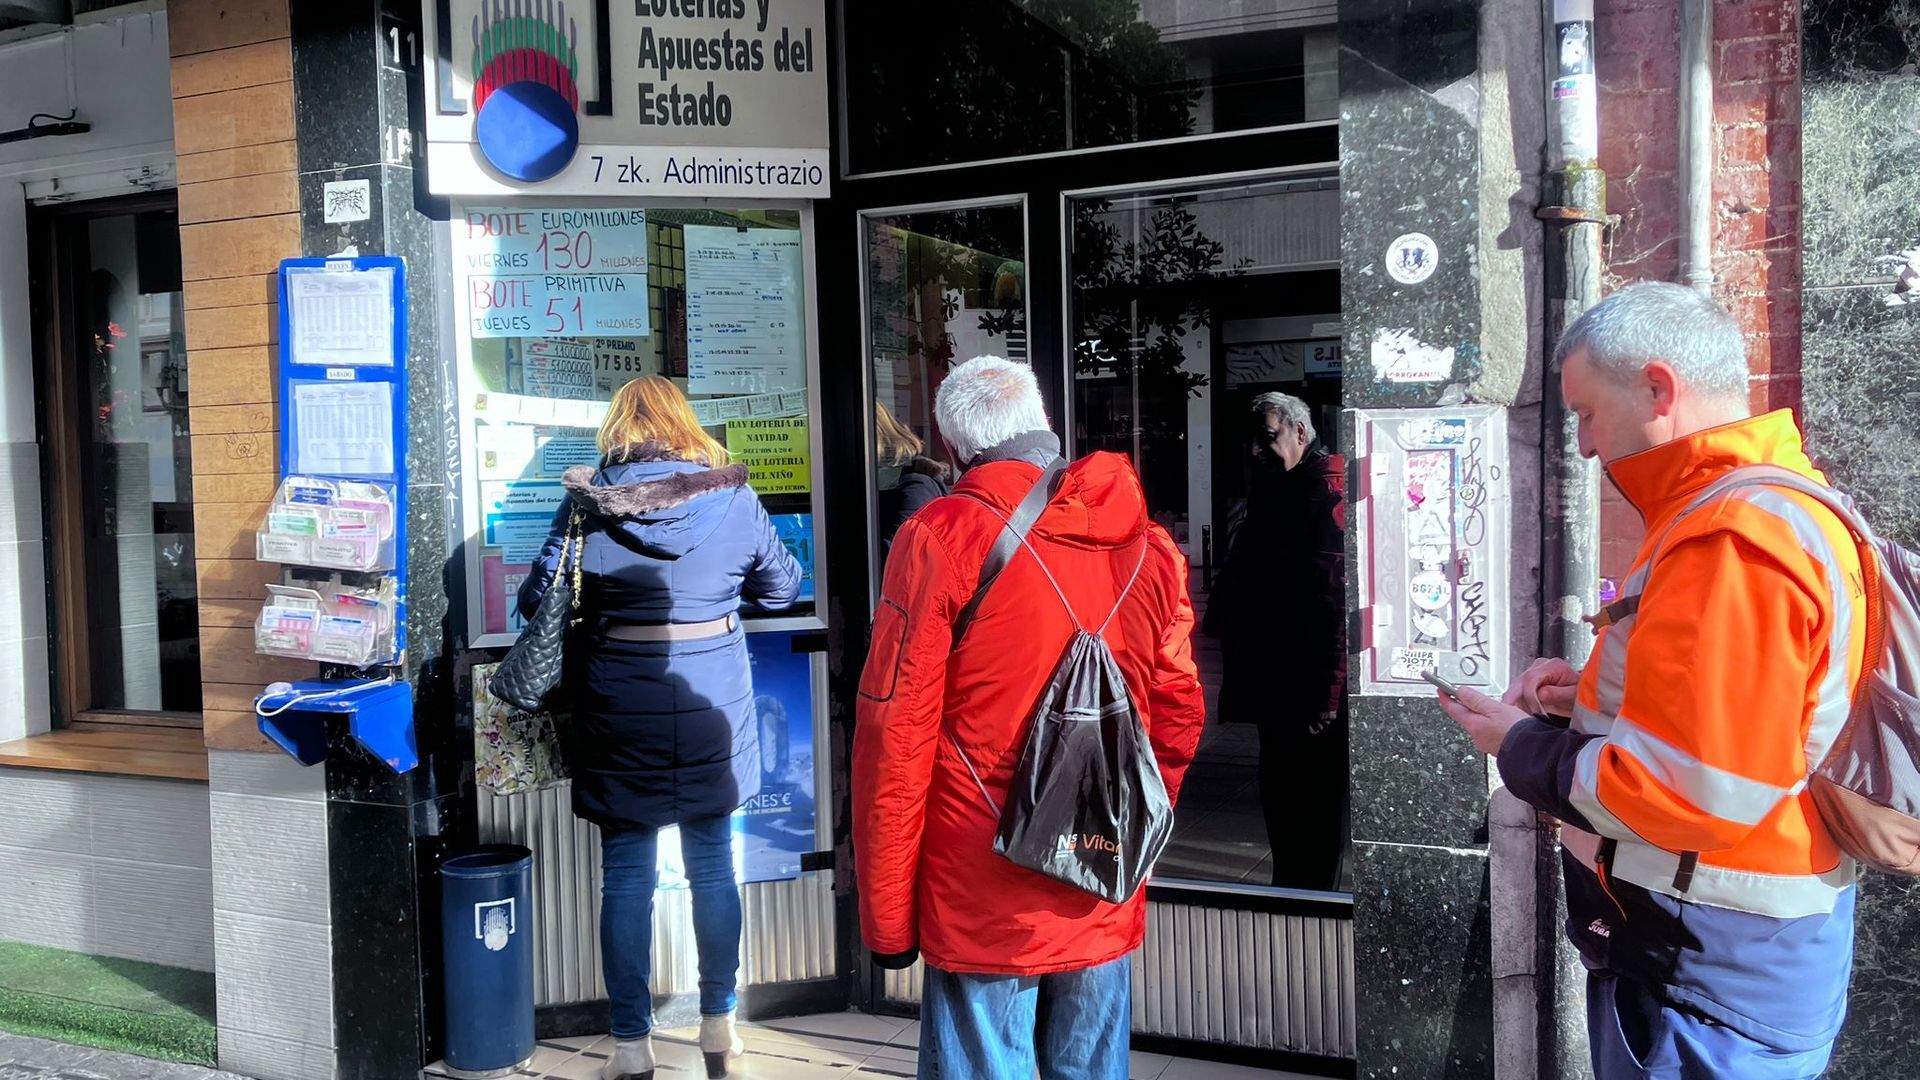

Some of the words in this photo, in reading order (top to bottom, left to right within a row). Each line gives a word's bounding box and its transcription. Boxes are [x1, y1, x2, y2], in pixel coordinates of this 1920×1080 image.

[389, 26, 417, 66] 11
[638, 27, 764, 80] Apuestas
[774, 28, 813, 72] del
[638, 81, 732, 127] Estado
[590, 156, 604, 183] 7
[618, 156, 650, 184] zk.
[664, 156, 823, 186] Administrazio
[467, 212, 535, 239] BOTE
[541, 210, 645, 230] EUROMILLONES
[467, 253, 529, 268] VIERNES
[536, 231, 592, 271] 130
[601, 256, 646, 268] MILLONES
[473, 279, 535, 309] BOTE
[545, 276, 626, 292] PRIMITIVA
[473, 316, 531, 331] JUEVES
[546, 296, 583, 333] 51
[596, 318, 642, 329] MILLONES
[606, 340, 636, 351] PREMIO
[728, 420, 749, 429] HAY
[793, 419, 807, 428] DE
[746, 433, 789, 442] NAVIDAD
[749, 472, 768, 480] DEL
[769, 470, 794, 480] NIÑO
[764, 457, 805, 466] LOTERIA
[782, 792, 792, 806] €
[1588, 925, 1611, 938] JUBA
